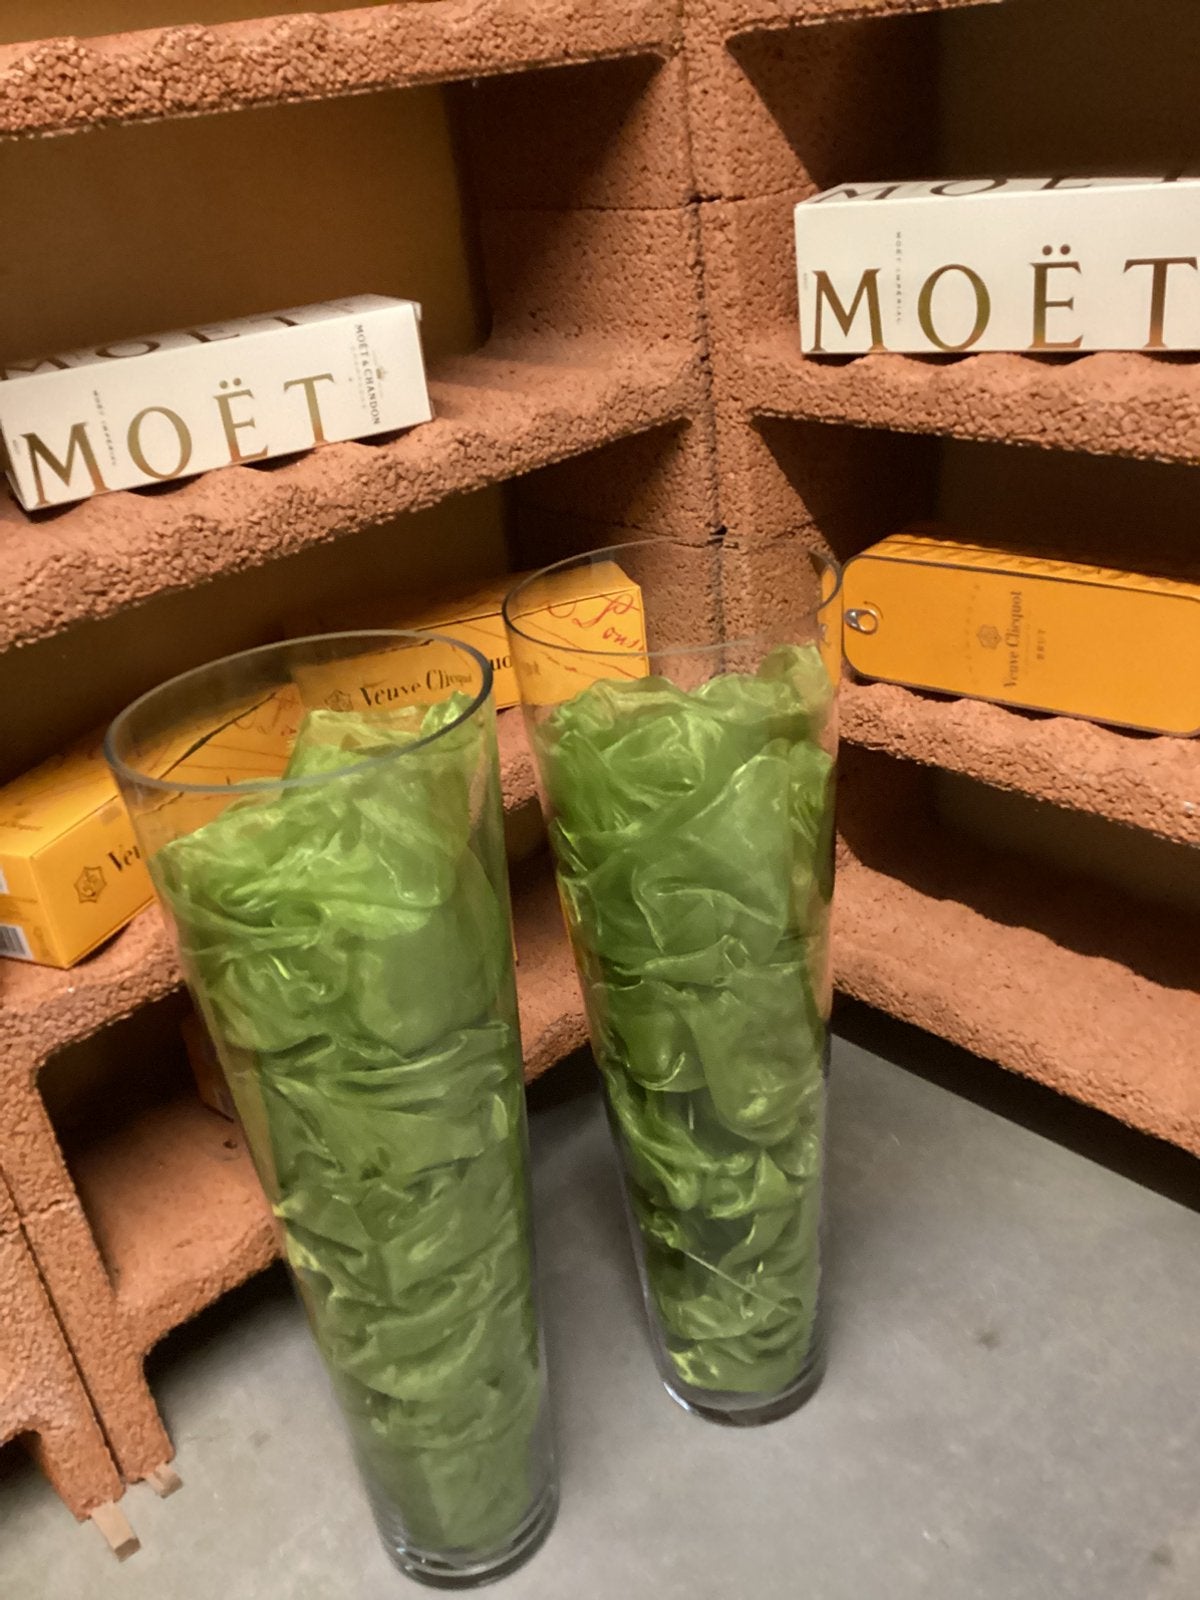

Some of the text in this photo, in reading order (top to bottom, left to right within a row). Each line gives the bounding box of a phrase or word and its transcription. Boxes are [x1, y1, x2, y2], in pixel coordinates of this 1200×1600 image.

[810, 244, 1198, 351] MOËT
[364, 368, 381, 425] CHANDON
[19, 372, 335, 505] MOËT
[1005, 591, 1024, 648] Clicquot
[359, 681, 422, 707] Veuve
